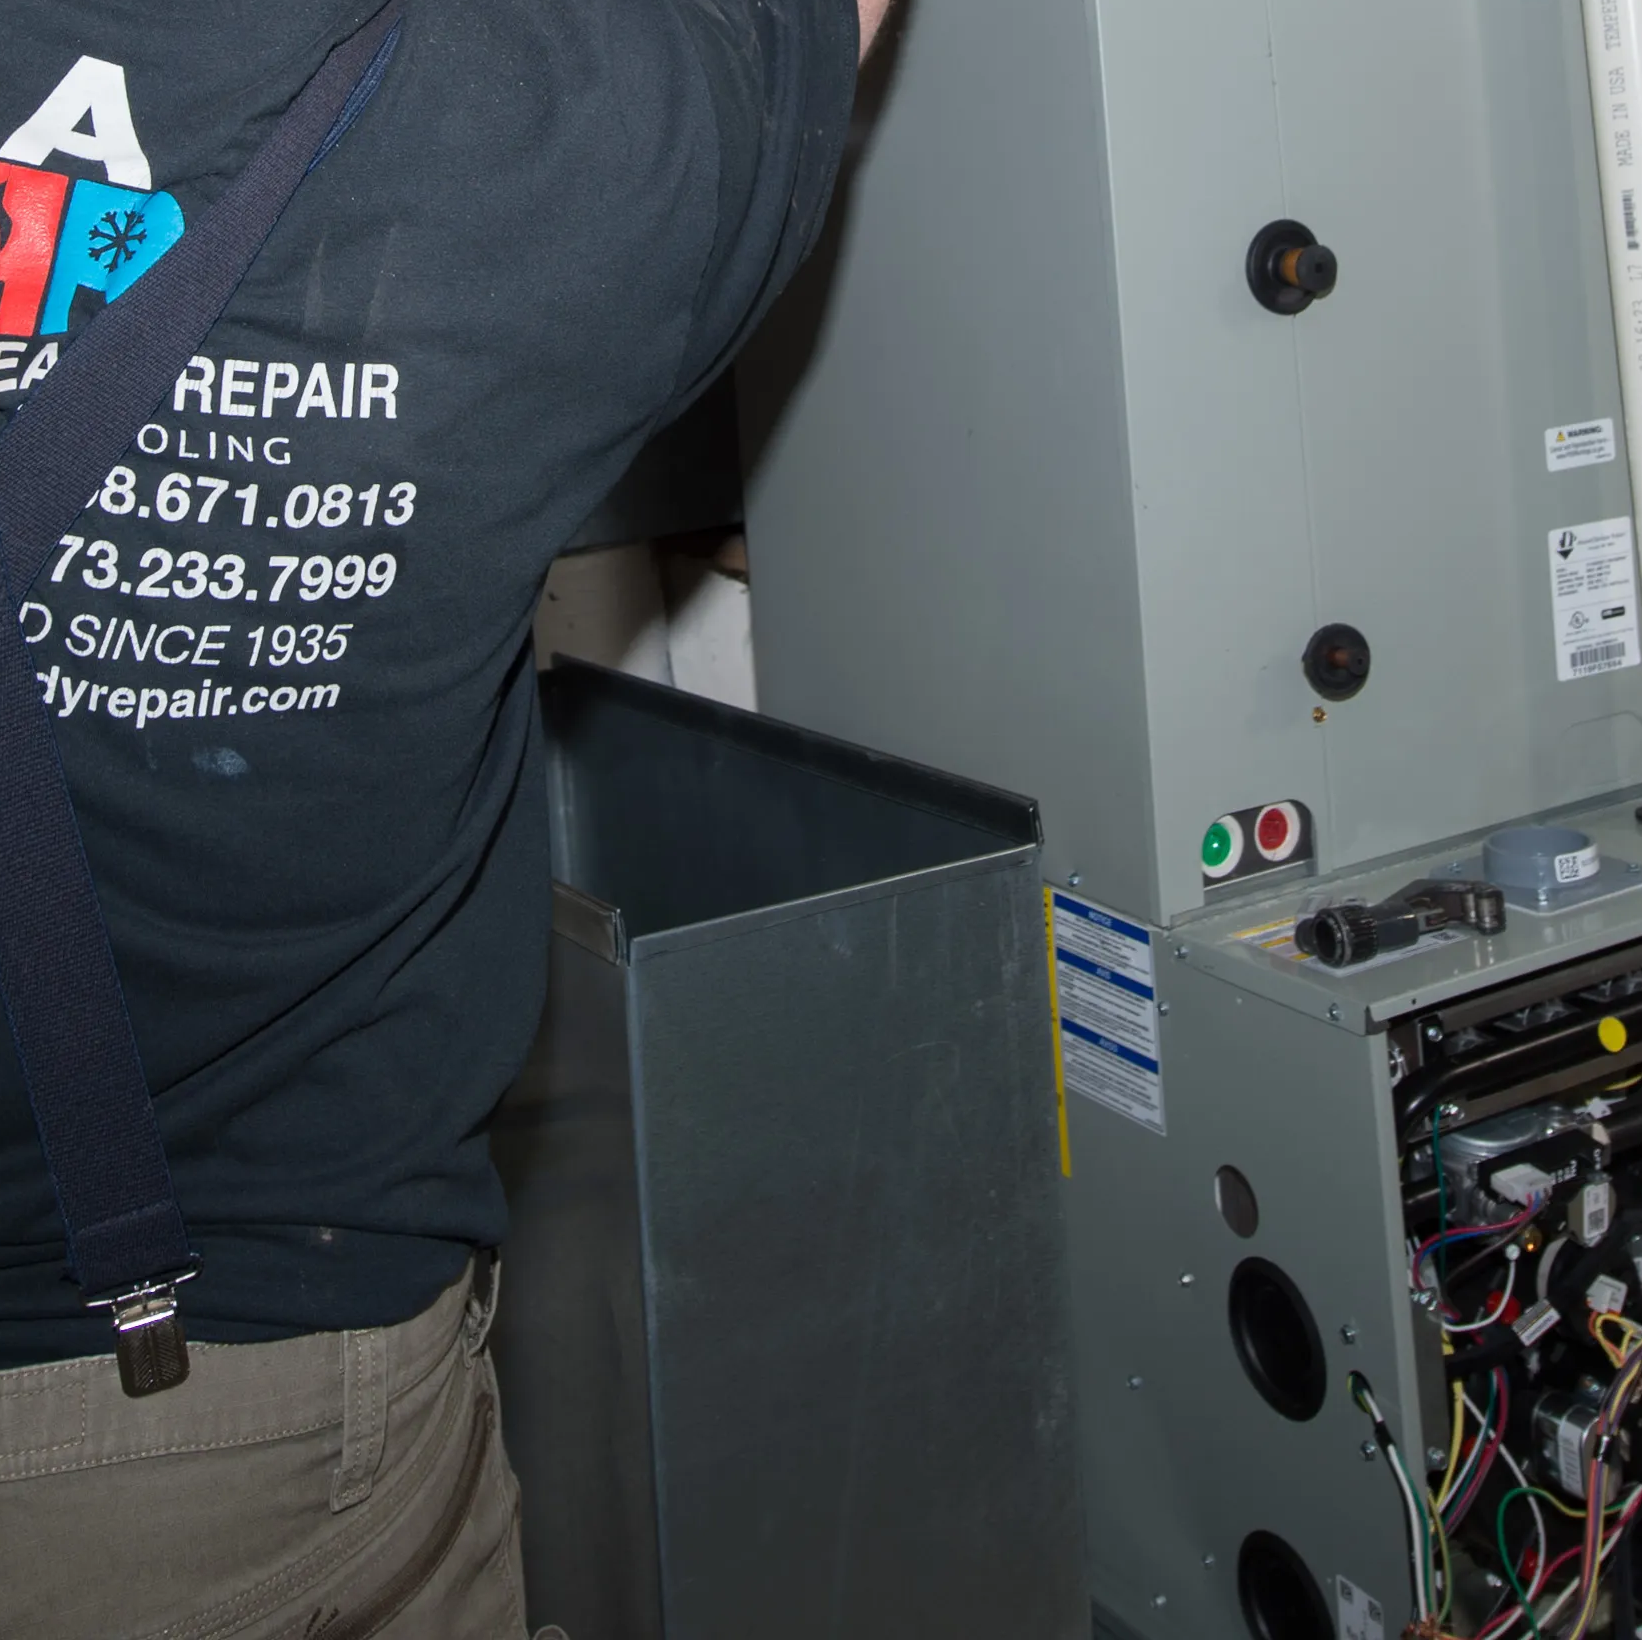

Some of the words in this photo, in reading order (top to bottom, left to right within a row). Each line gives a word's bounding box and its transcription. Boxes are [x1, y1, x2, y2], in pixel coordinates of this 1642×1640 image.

[1608, 66, 1626, 94] USA
[1611, 103, 1628, 120] IN
[1615, 130, 1634, 166] MADE
[173, 354, 399, 420] REPAIR
[137, 423, 292, 466] OLING
[85, 464, 417, 529] 8.671.0813
[50, 534, 397, 600] 73.233.7999
[65, 614, 227, 667] SINCE
[246, 623, 354, 668] 1935
